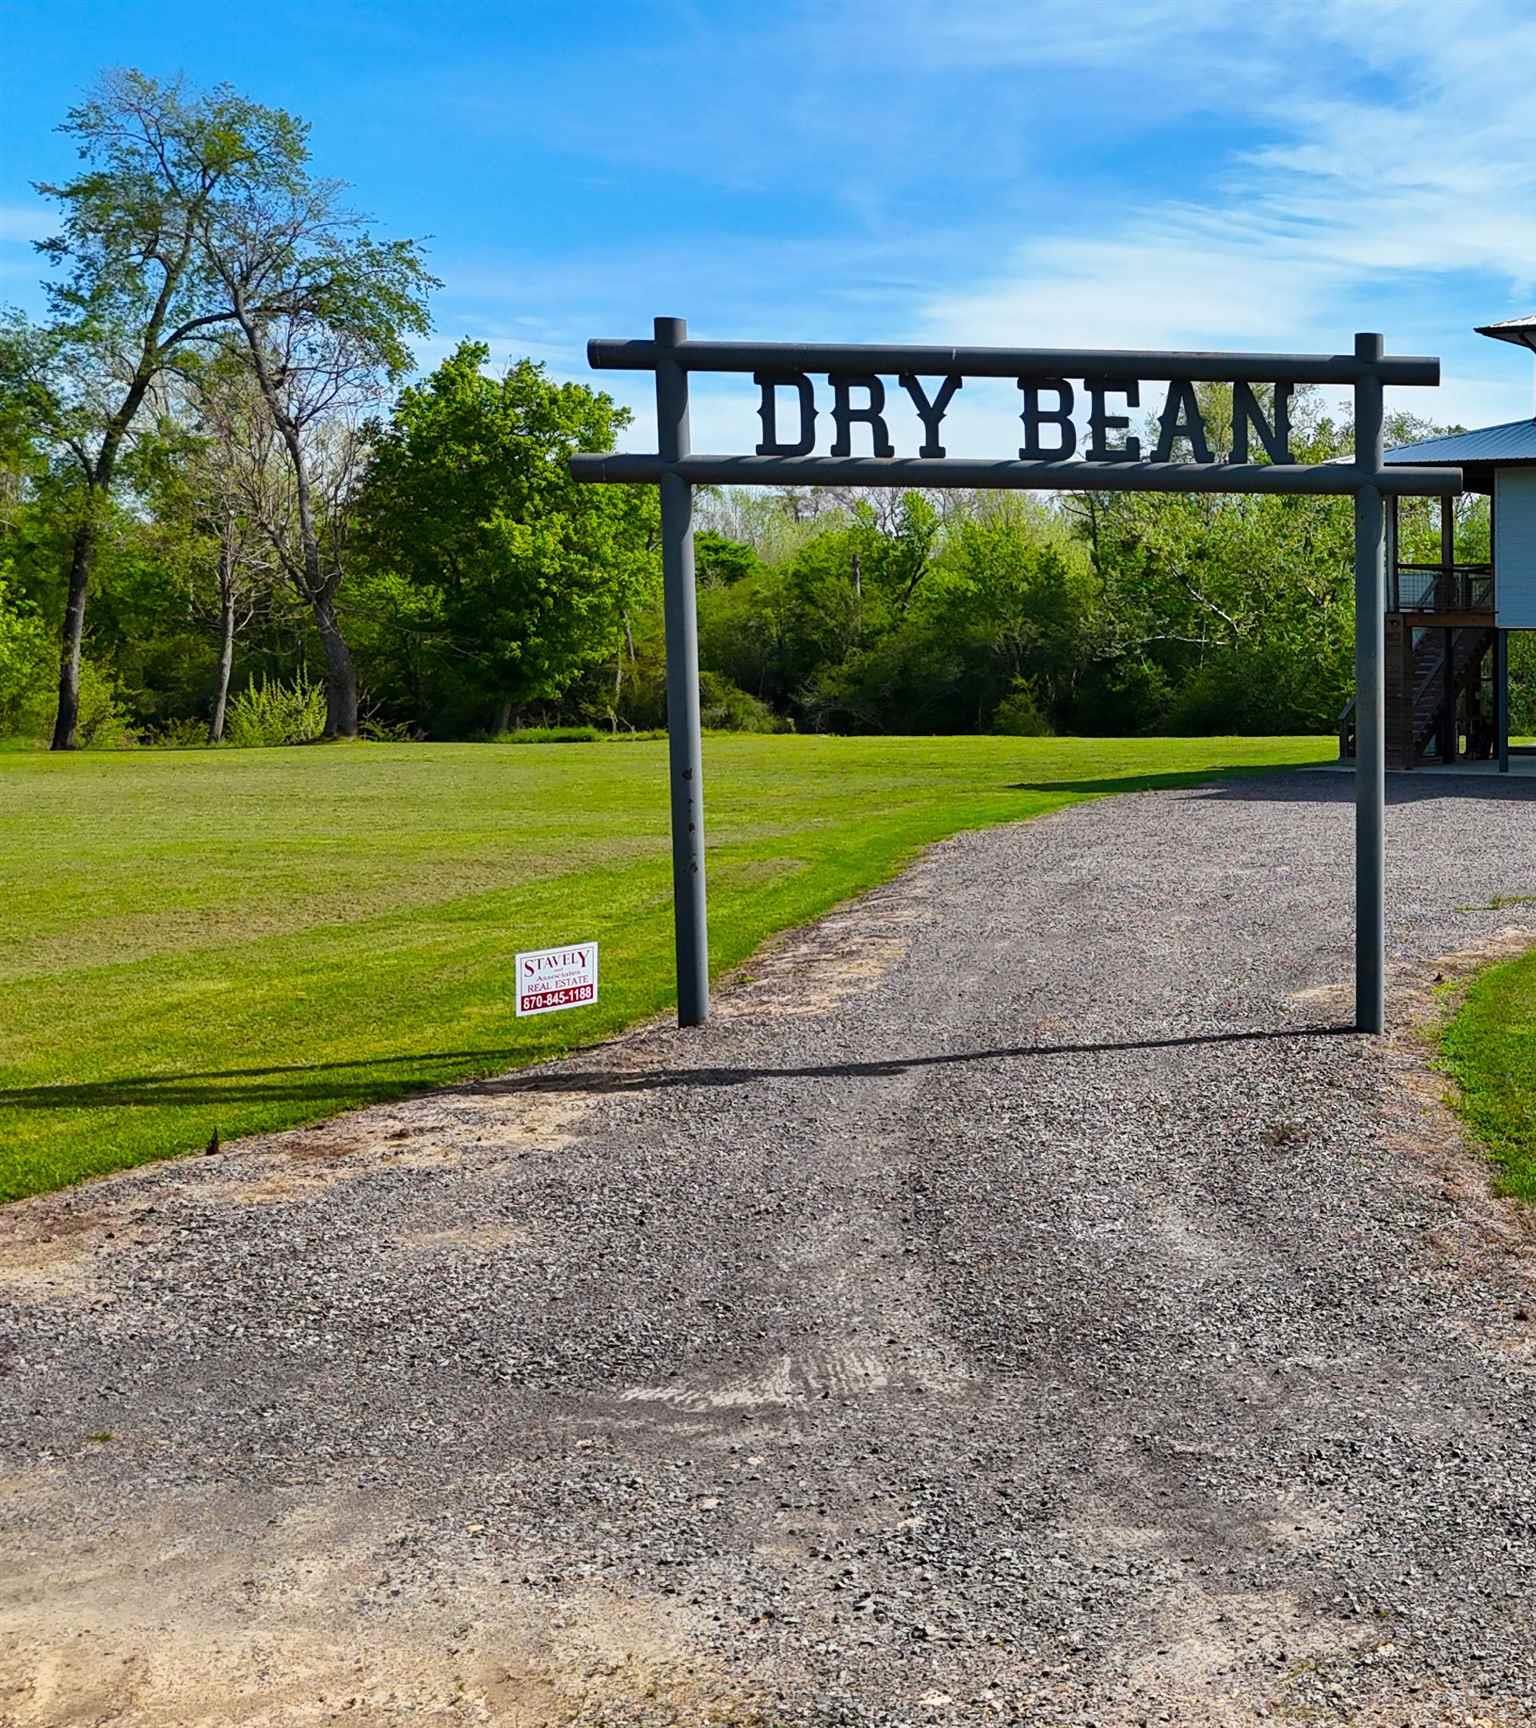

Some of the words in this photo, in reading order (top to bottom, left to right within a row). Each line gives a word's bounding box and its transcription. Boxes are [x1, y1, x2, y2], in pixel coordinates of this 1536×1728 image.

[754, 372, 962, 458] DRY
[1018, 377, 1294, 464] BEAN
[524, 950, 590, 977] STAVELY
[527, 982, 552, 993] REAL
[555, 975, 589, 988] ESTATE
[523, 987, 592, 1010] 870-845-1188
